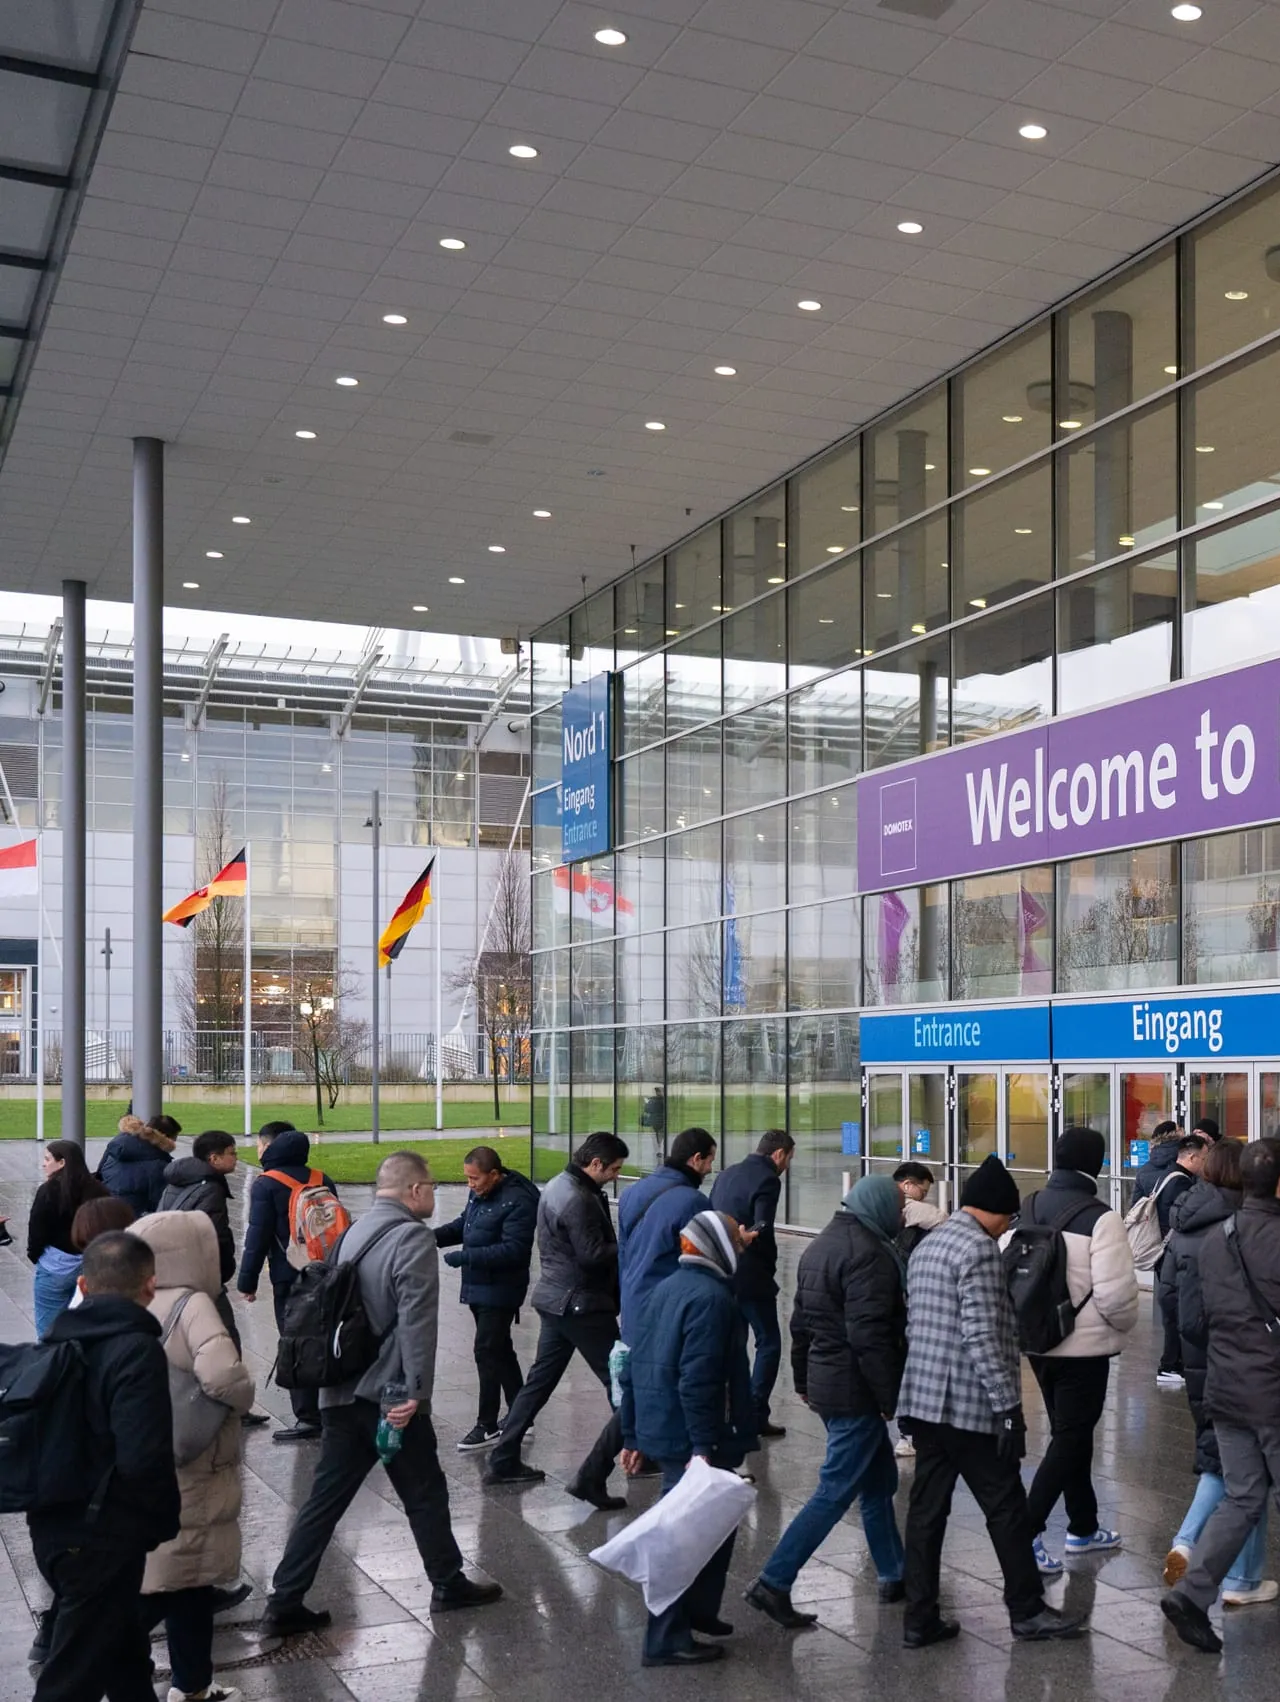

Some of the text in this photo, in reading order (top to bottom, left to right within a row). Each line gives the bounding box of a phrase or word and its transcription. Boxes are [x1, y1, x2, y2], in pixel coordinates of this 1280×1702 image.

[563, 711, 606, 767] Nord 1
[965, 742, 1178, 847] Welcome
[1195, 708, 1255, 801] to
[564, 784, 595, 816] Eingang
[564, 819, 598, 846] Entrance
[883, 819, 913, 837] DOMOTEX
[913, 1016, 982, 1048] Entrance
[1132, 1002, 1223, 1053] Eingang
